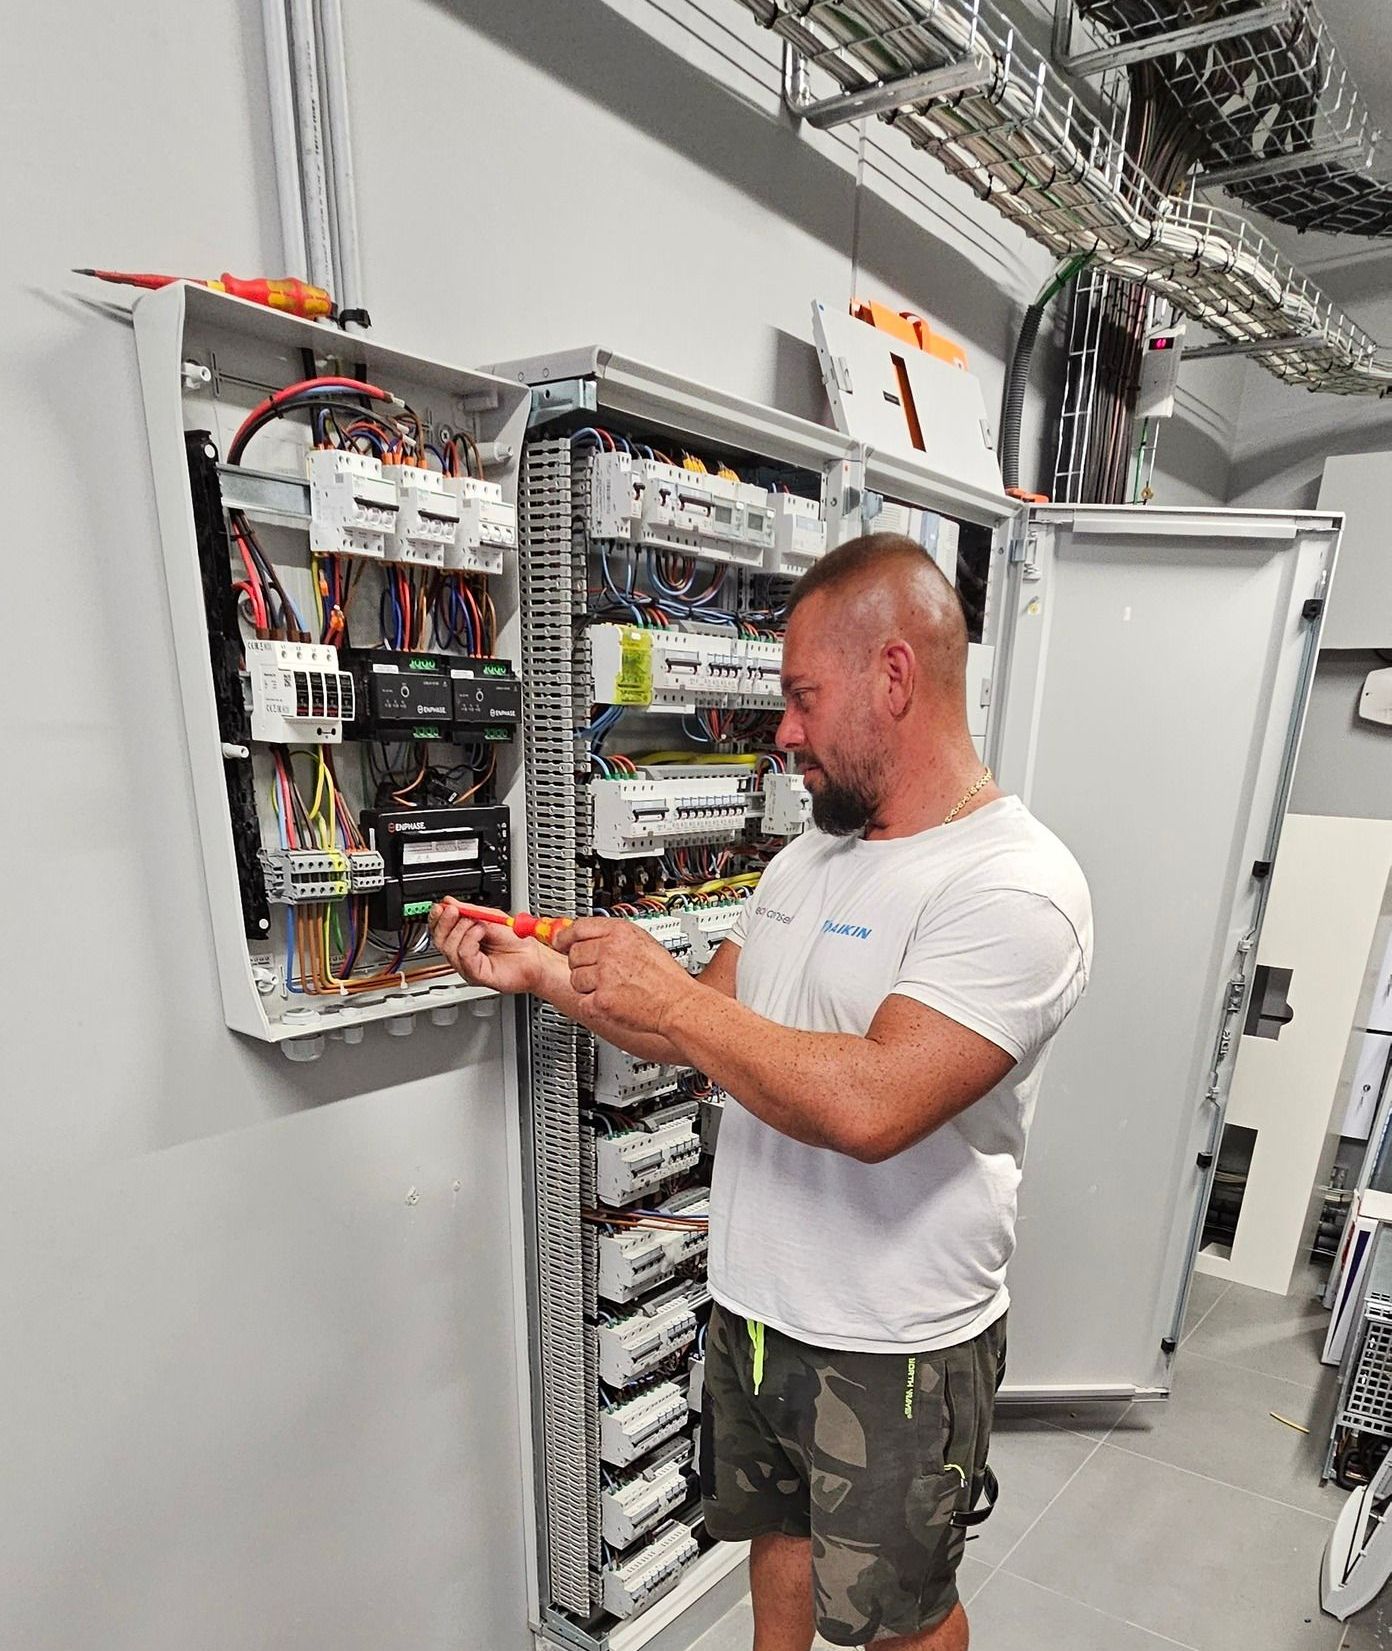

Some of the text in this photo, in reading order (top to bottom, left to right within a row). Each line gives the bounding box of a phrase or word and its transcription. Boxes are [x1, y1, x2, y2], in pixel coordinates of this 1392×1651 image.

[395, 821, 426, 832] ENPHASE
[822, 919, 872, 940] DAIKIN
[906, 1358, 916, 1387] NORTH
